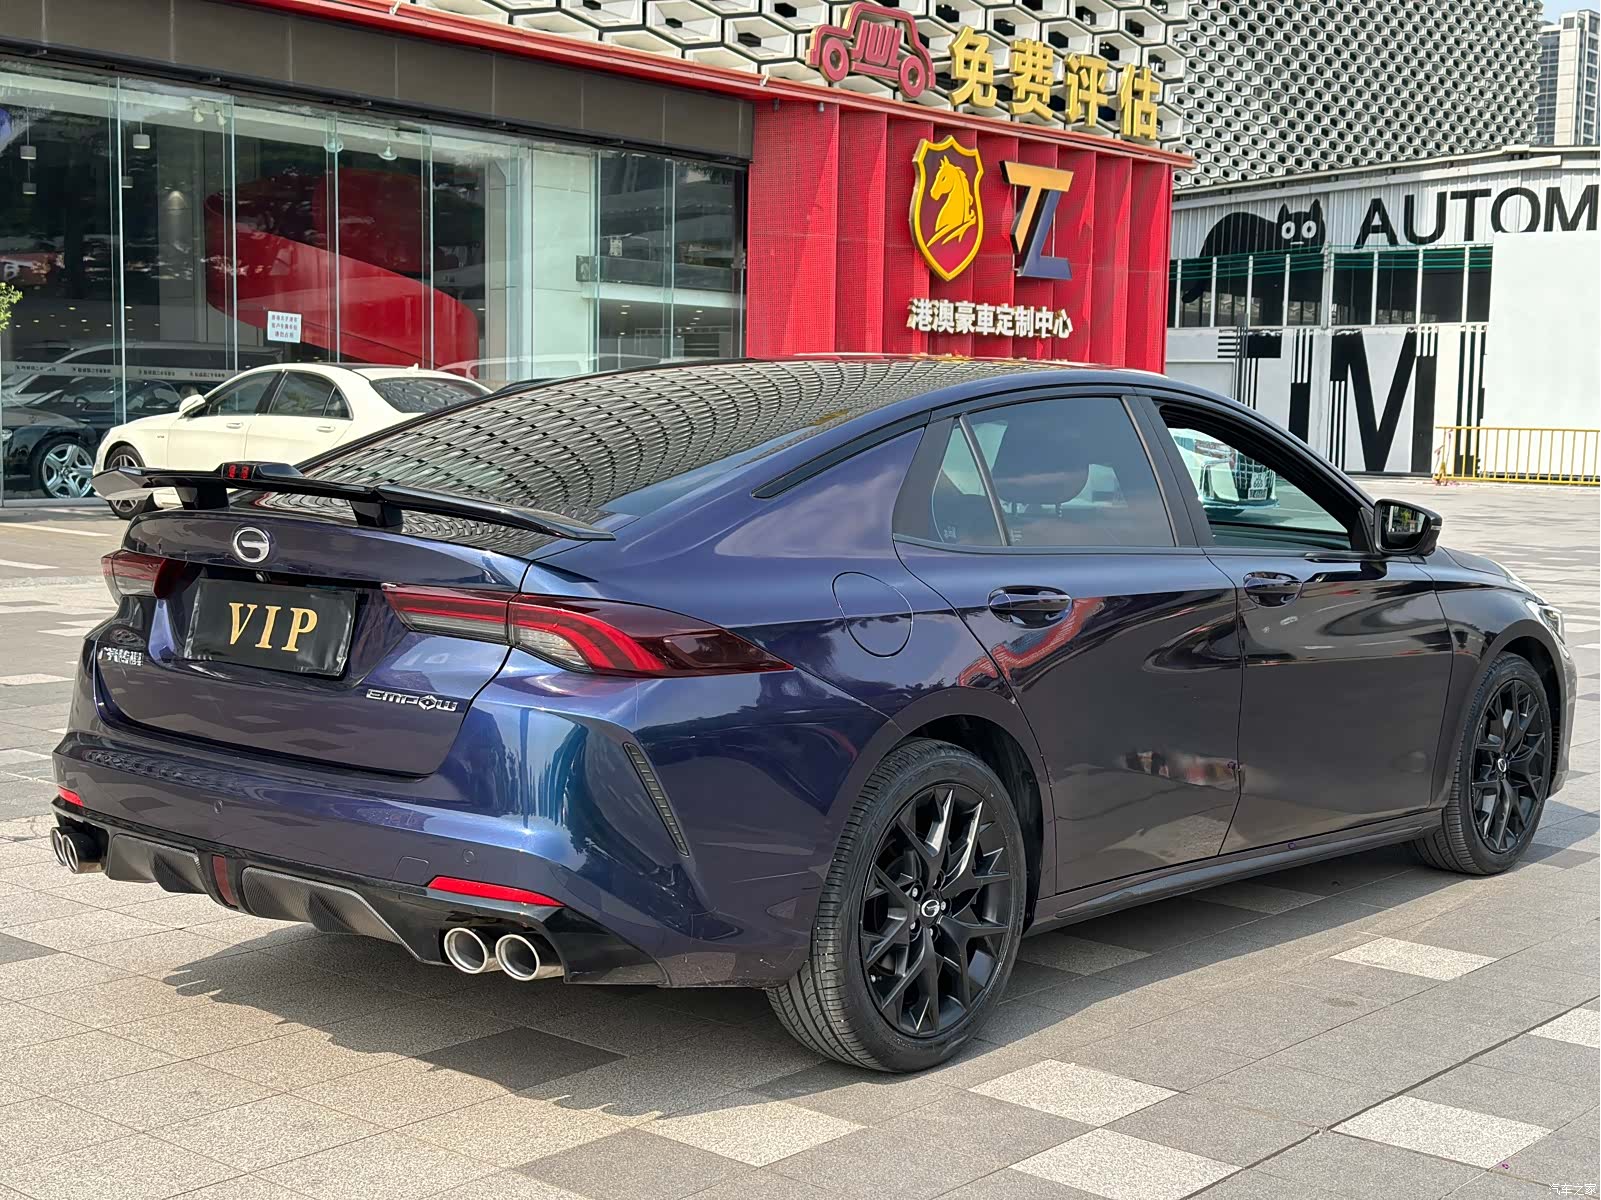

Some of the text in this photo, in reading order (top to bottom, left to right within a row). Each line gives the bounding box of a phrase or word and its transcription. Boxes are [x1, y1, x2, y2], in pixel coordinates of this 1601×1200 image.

[948, 25, 1161, 140] 免费评估
[1353, 184, 1600, 250] AUTOM
[906, 297, 1074, 339] 港澳豪車定制中心
[228, 602, 319, 652] VIP
[365, 688, 459, 711] EMPOW
